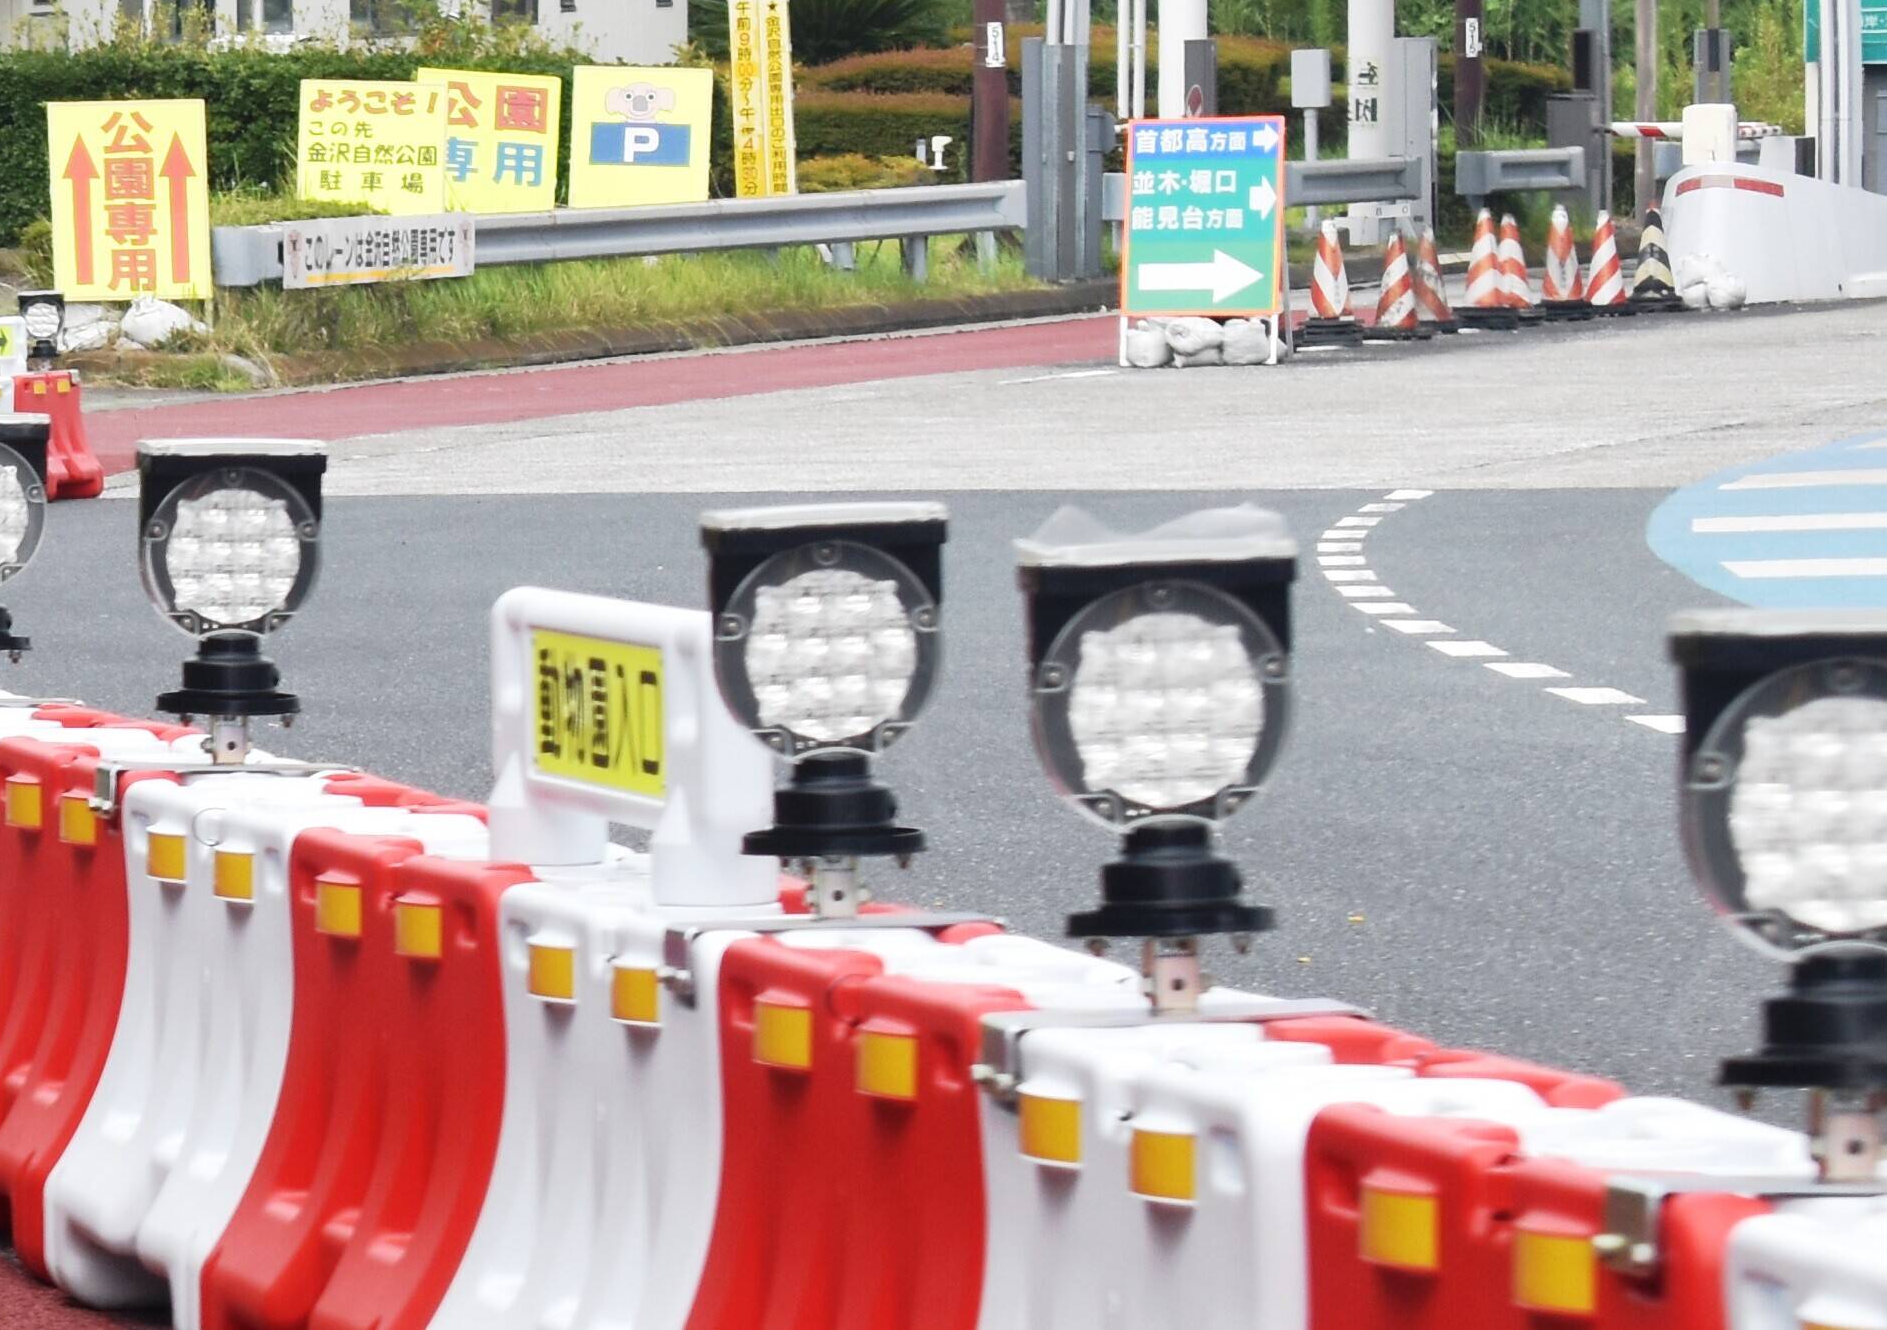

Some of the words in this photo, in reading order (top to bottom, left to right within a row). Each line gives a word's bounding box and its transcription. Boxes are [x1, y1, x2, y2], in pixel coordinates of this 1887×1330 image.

[447, 80, 549, 134] 公園
[308, 121, 373, 138] この先
[623, 126, 659, 162] P
[1135, 127, 1247, 154] 首都高方面
[307, 142, 437, 166] 金沢自然公園
[445, 136, 543, 187] 専用
[320, 170, 424, 194] 駐車場
[100, 111, 158, 291] 公園専用
[1131, 205, 1244, 231] 能見台方面
[304, 227, 456, 270] このレーンは金沢自然公園専用です
[539, 647, 660, 776] 動物園入口
